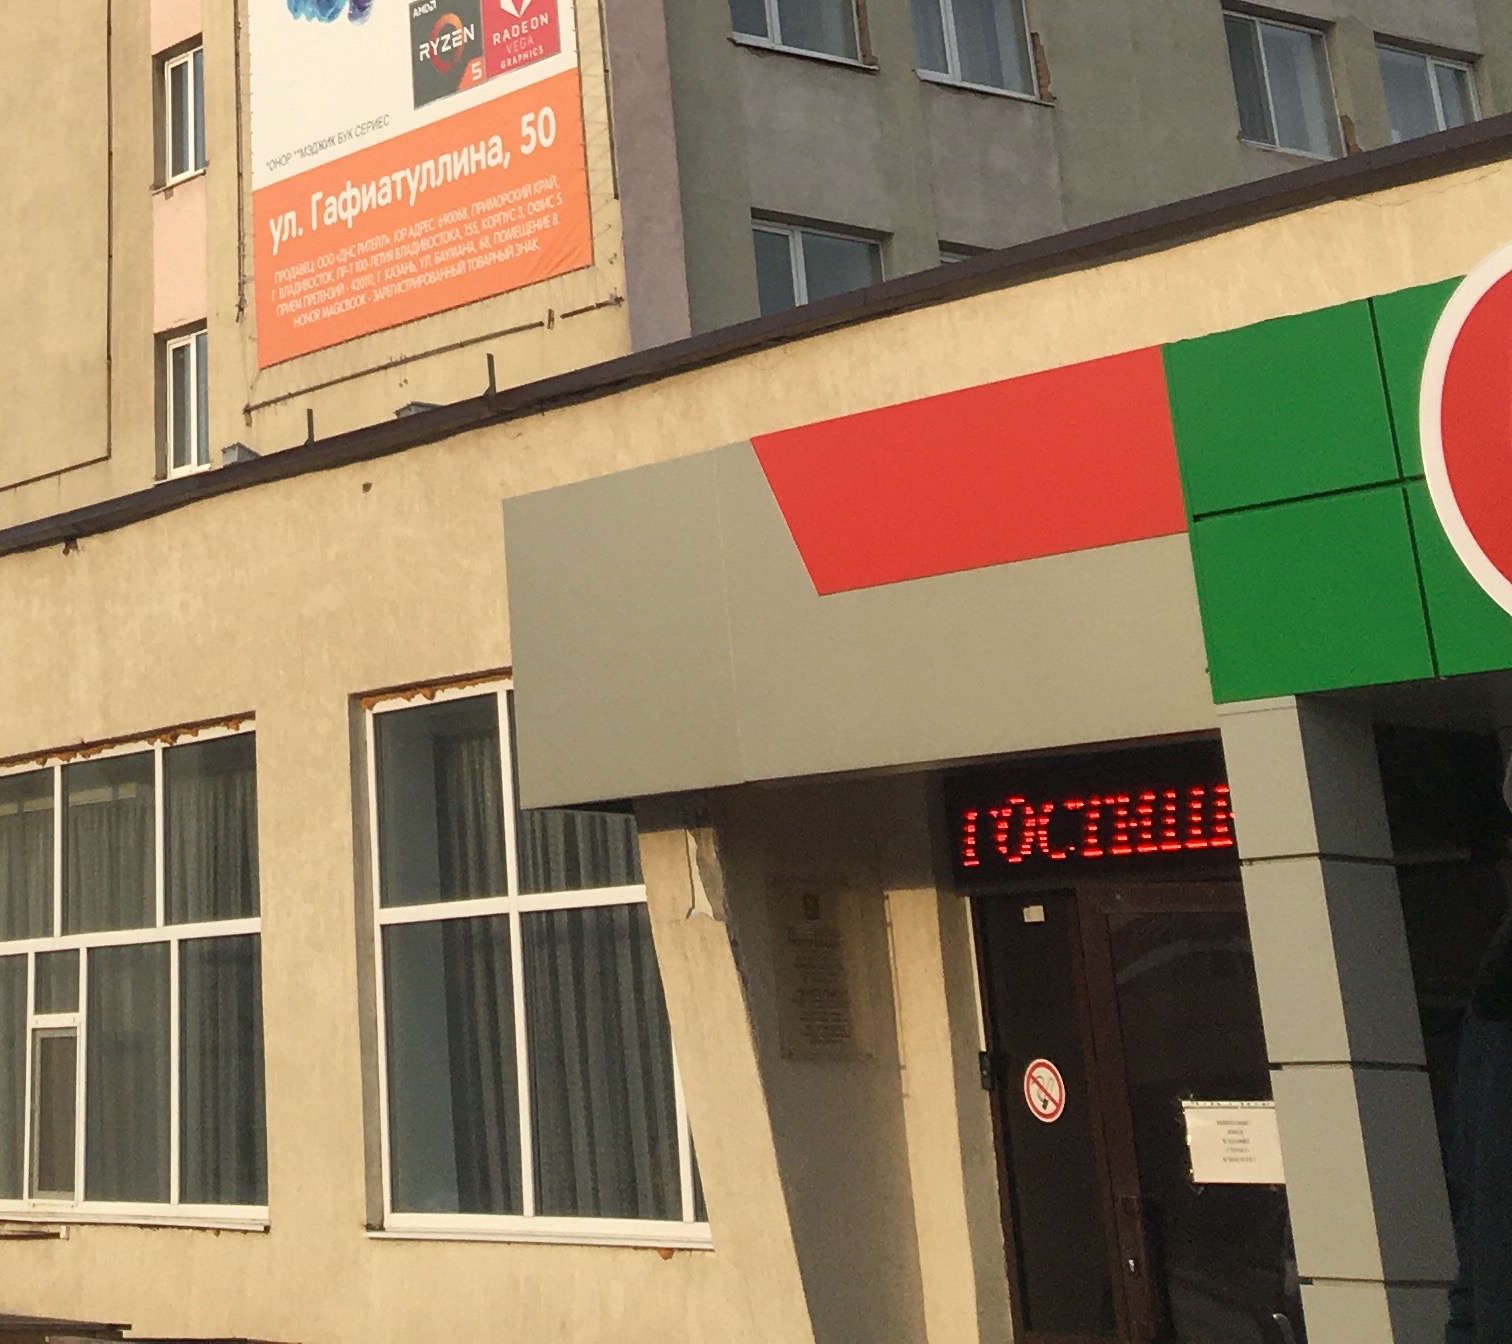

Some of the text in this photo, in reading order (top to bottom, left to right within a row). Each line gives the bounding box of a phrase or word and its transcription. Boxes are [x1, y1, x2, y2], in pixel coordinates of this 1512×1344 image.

[419, 23, 475, 62] RYZEN
[492, 12, 549, 46] RADEON
[500, 45, 544, 70] GRAPHICS
[506, 34, 535, 54] VEGA
[471, 61, 483, 81] 5
[269, 106, 556, 256] ул. Гафиатуллина, 50
